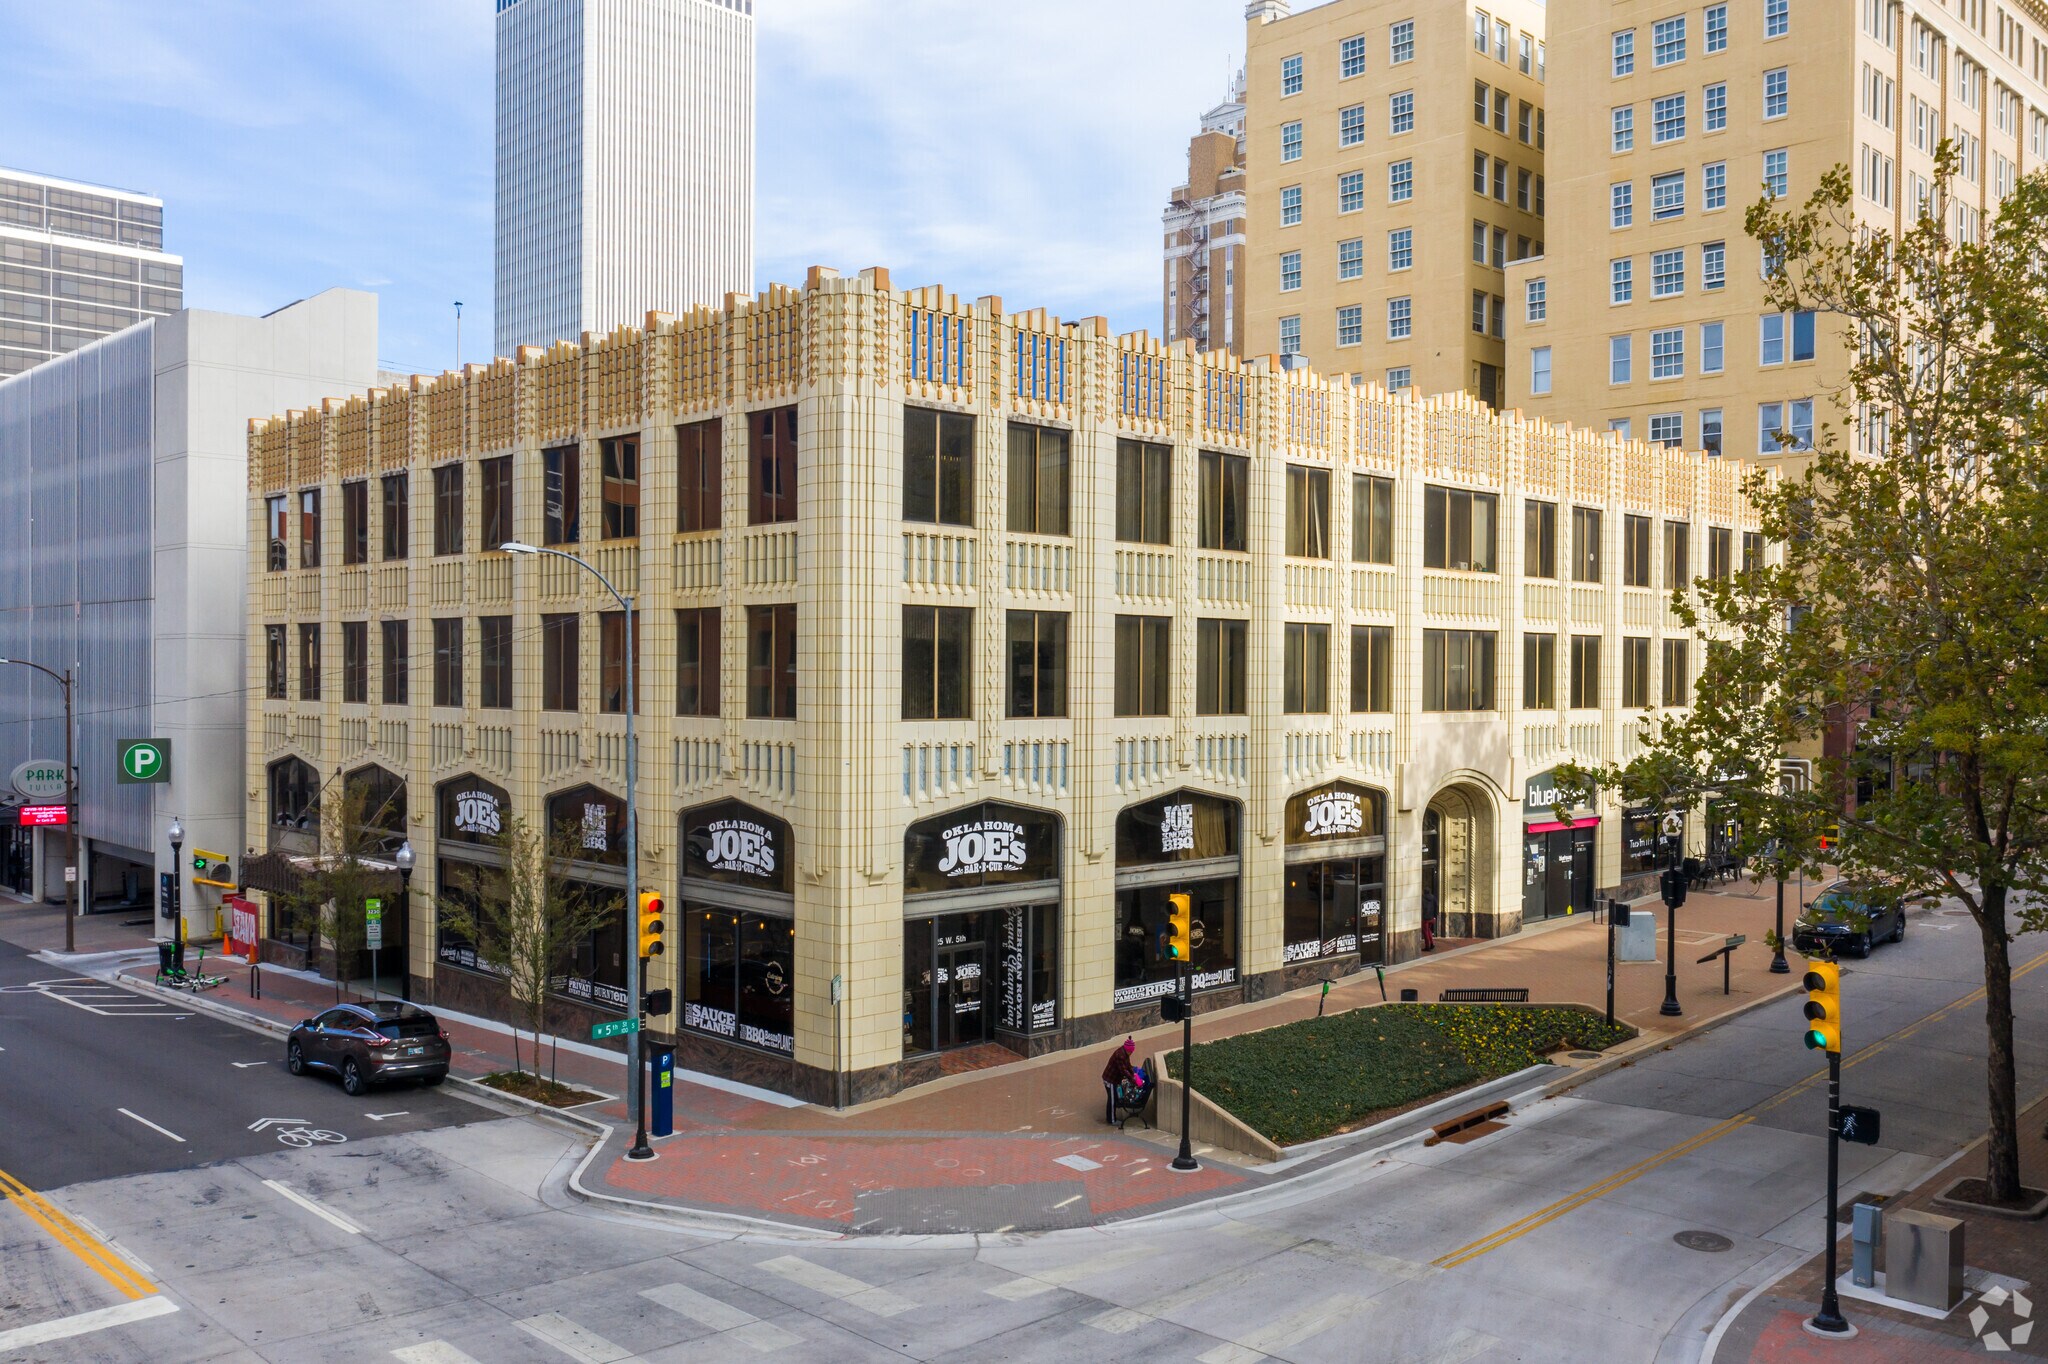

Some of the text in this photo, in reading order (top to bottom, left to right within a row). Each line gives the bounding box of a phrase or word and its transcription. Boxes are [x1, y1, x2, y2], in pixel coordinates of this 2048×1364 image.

[134, 749, 156, 774] P
[26, 769, 65, 782] PARK
[28, 783, 62, 792] TULSA
[456, 790, 499, 807] OKLAHOMA
[1307, 791, 1361, 807] OKLAHOMA
[455, 799, 500, 832] JOE'S
[1160, 804, 1193, 832] JOE
[1304, 800, 1363, 832] JOE'S
[708, 820, 773, 842] OKLAHOMA
[941, 821, 1024, 840] OKLAHOMA
[706, 829, 775, 872] JOE'S
[938, 831, 1027, 872] JOE'S
[1161, 836, 1195, 852] BBQ
[945, 936, 954, 945] W.
[955, 934, 967, 943] 5th
[1286, 940, 1320, 955] SAUCE
[1286, 949, 1320, 961] PLANET
[1191, 974, 1206, 990] BQ
[1218, 967, 1236, 985] PLANET
[568, 980, 592, 993] PRIVAT
[1004, 954, 1018, 1027] Champion
[1114, 986, 1146, 998] WORLD
[1145, 981, 1176, 997] RIBS
[1114, 992, 1147, 1004] FAMOUS
[692, 1003, 736, 1027] SAUCE
[605, 1023, 619, 1036] 5th
[692, 1016, 736, 1037] PLANET
[745, 1025, 766, 1047] BBQ
[777, 1033, 795, 1052] PLANET
